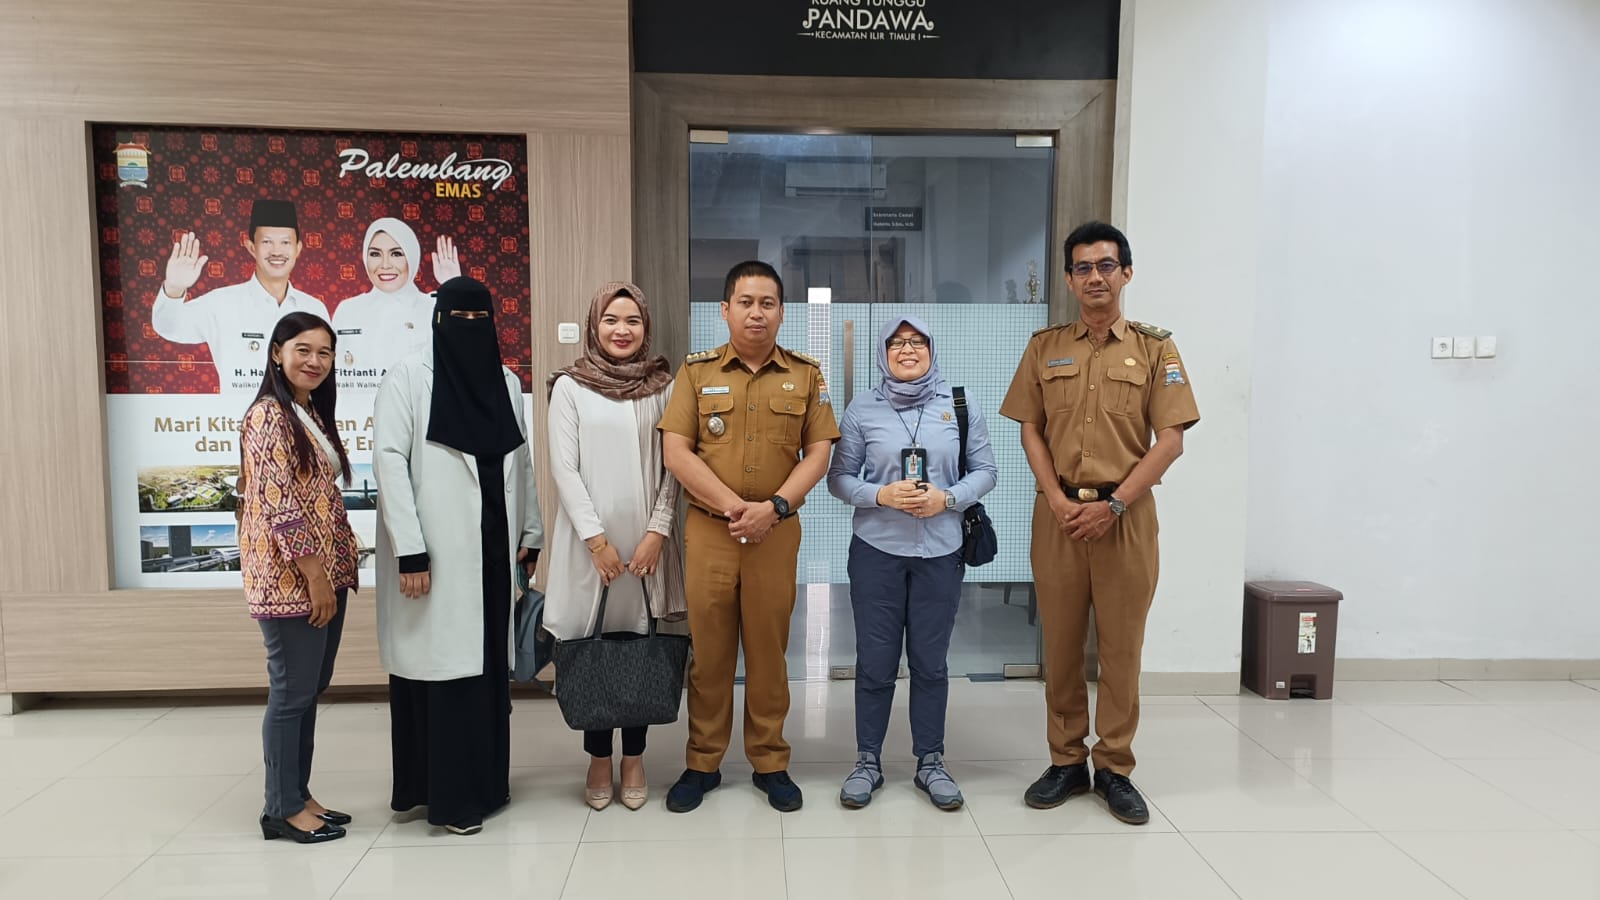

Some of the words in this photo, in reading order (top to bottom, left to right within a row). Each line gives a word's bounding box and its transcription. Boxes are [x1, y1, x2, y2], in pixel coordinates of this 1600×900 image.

[802, 8, 934, 31] PANDAWA
[815, 31, 867, 40] KECAMATAN
[869, 32, 885, 40] ILIR
[889, 32, 916, 41] TIMUR
[339, 148, 512, 191] Palembang
[435, 182, 482, 198] EMAS
[234, 368, 246, 377] H.
[333, 368, 377, 377] Fitrianti
[231, 381, 260, 389] Walikot
[154, 416, 201, 432] Mari
[207, 416, 242, 432] Kita
[195, 436, 232, 452] dan
